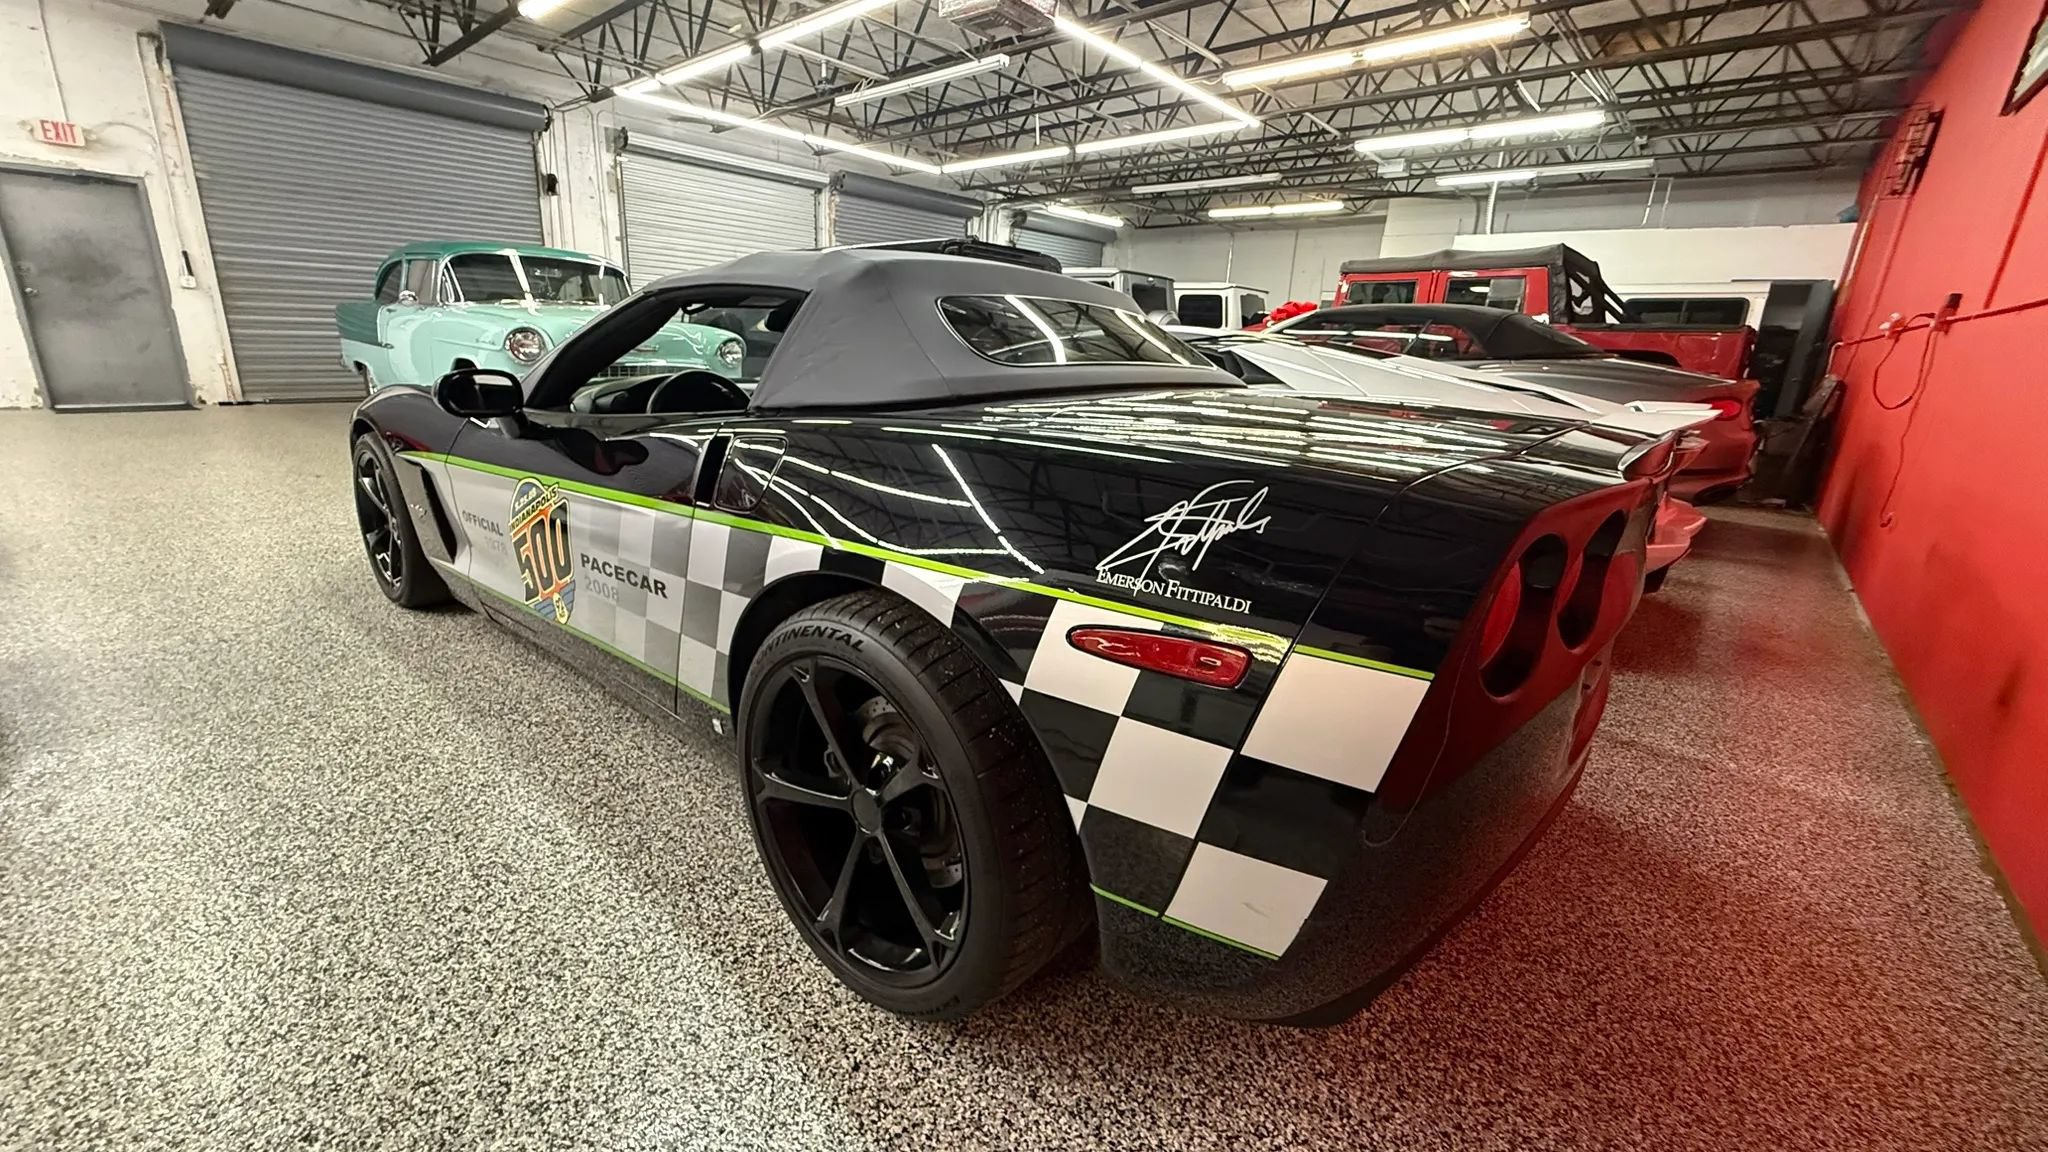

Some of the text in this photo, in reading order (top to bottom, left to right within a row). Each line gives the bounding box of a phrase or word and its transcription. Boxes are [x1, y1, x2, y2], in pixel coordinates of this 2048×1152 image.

[40, 120, 76, 144] EXIT
[462, 509, 503, 537] OFFICIAL
[509, 486, 558, 530] NDIANAPOLIS
[511, 499, 574, 604] 500
[580, 552, 668, 600] PACECAR
[584, 575, 620, 602] 2008
[1096, 567, 1253, 614] EMERSON FITTIPALDI
